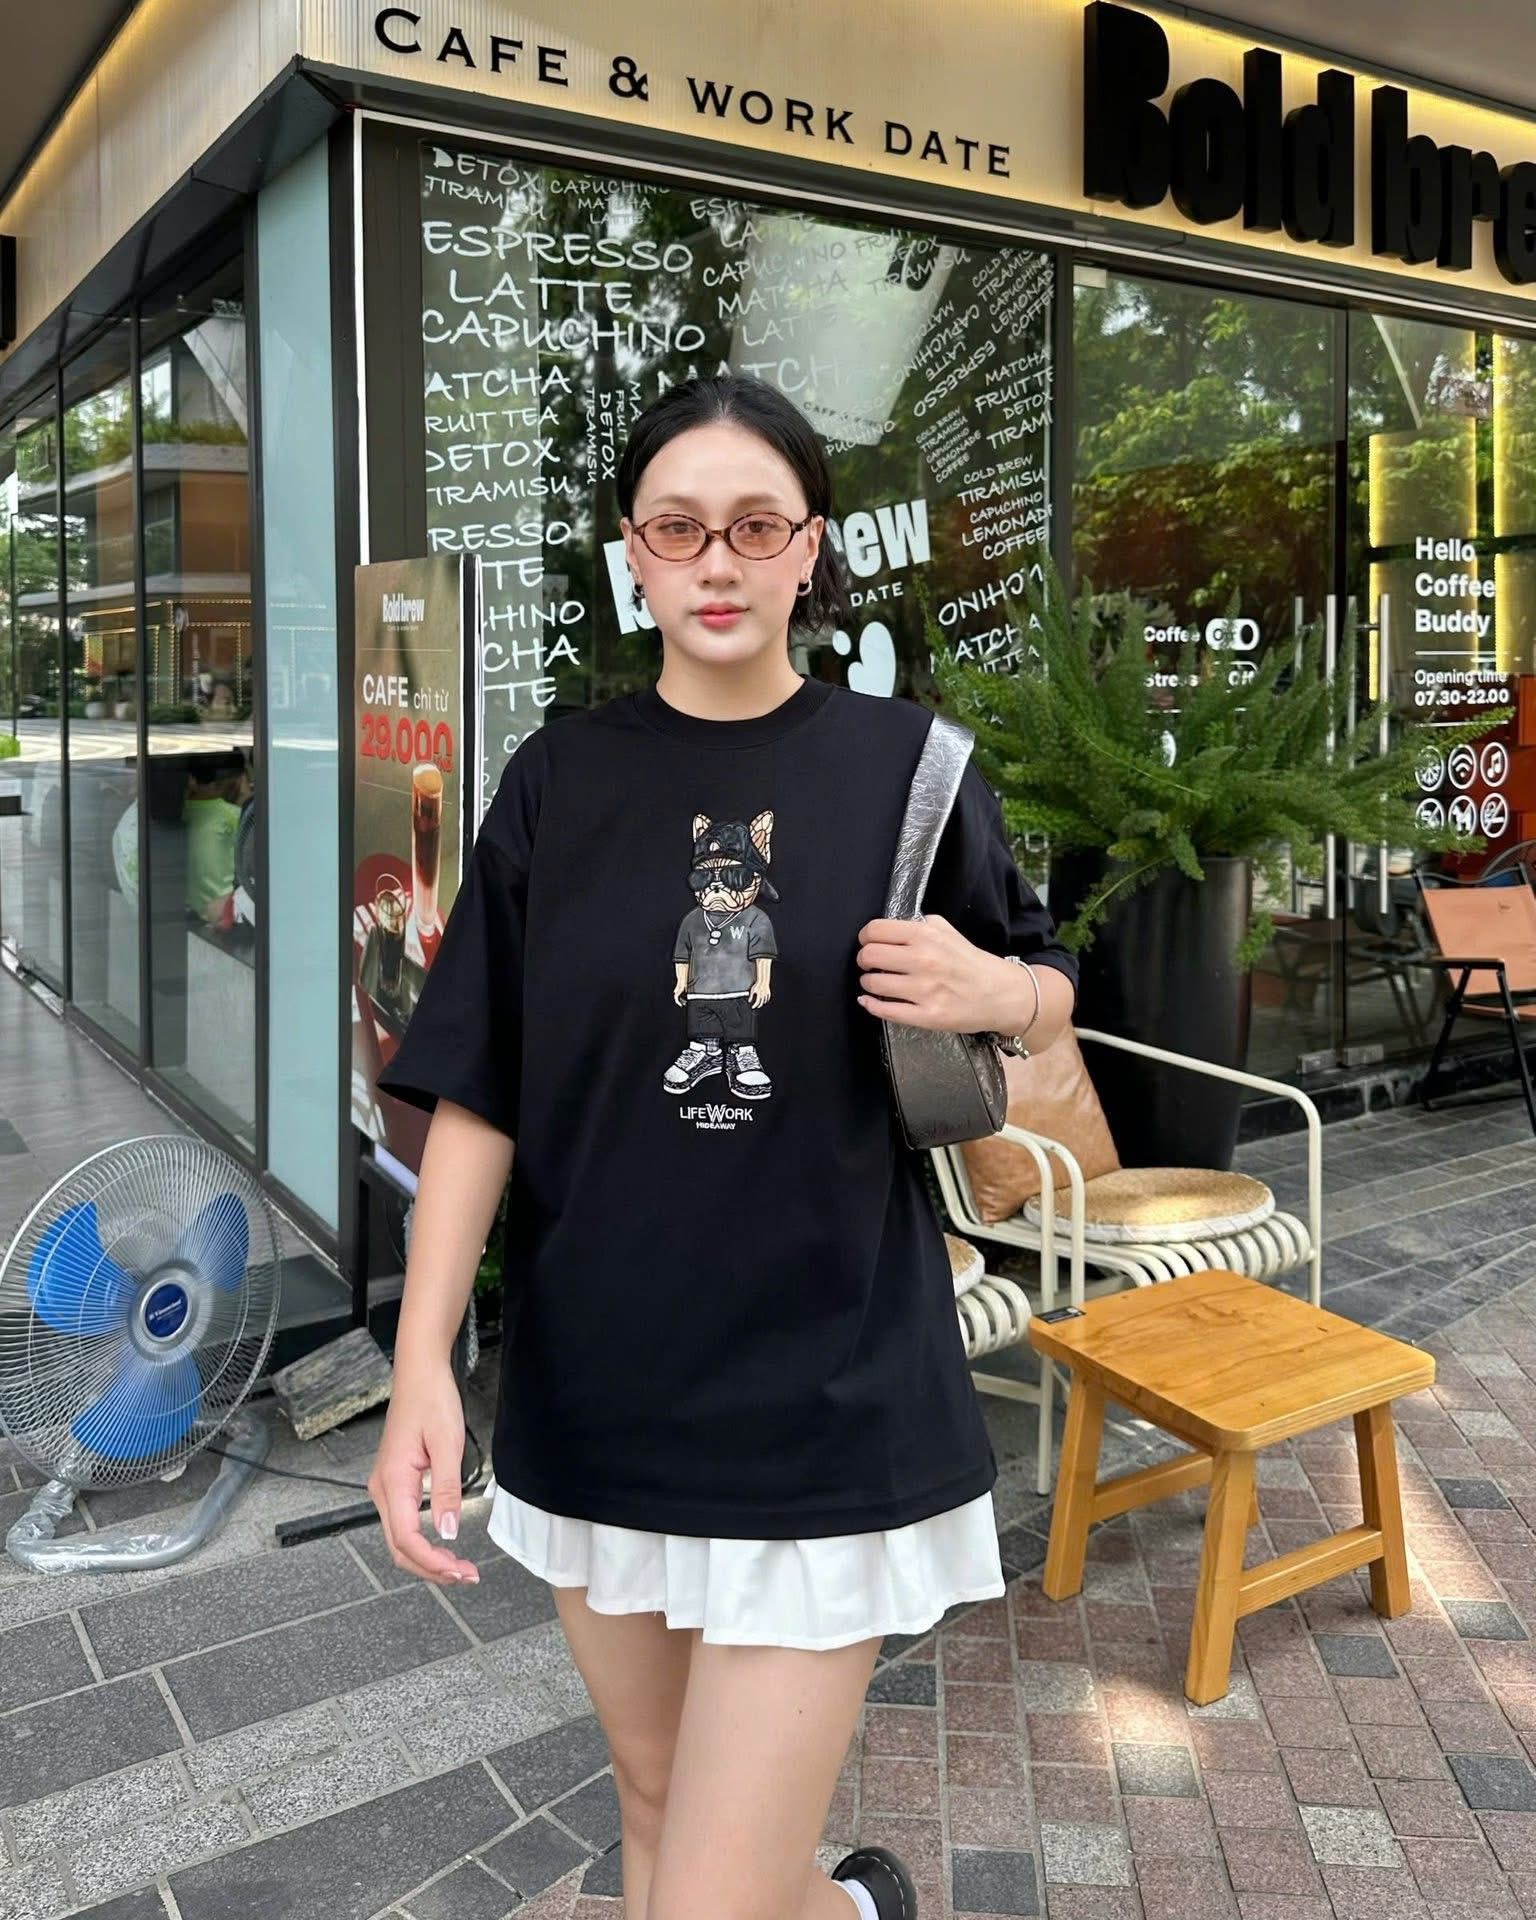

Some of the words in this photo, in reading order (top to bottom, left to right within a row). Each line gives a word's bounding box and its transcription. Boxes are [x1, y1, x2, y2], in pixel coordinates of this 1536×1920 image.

[374, 7, 569, 87] CAFE
[609, 55, 650, 103] &
[686, 76, 857, 145] WORK
[883, 120, 1012, 179] DATE
[1083, 0, 1355, 248] Bold
[432, 147, 542, 194] DETOX
[422, 221, 694, 273] ESPRESSO
[449, 269, 633, 313] LATTE
[421, 309, 706, 352] CAPUCHINO
[913, 340, 996, 417] ESPRESSO
[985, 348, 1050, 386] MATCHA
[974, 376, 1032, 414] FRUIT
[1003, 391, 1054, 421] DETOX
[502, 405, 560, 429] TEA
[586, 386, 598, 485] TIRAMISU
[599, 391, 616, 480] DETOX
[935, 452, 971, 484] COFFEE
[963, 466, 996, 485] COLD
[996, 453, 1034, 475] BREW
[957, 468, 1047, 507] TIRAMISU
[969, 491, 1044, 524] CAPUCHINO
[982, 527, 1049, 560] COFFEE
[1415, 536, 1476, 562] Hello
[850, 581, 904, 608] DATE
[1414, 571, 1496, 598] Coffee
[1415, 608, 1491, 638] Buddy
[362, 673, 409, 708] CAFE
[1414, 668, 1478, 688] Opening
[1414, 689, 1510, 707] 07.30-22.00
[679, 1103, 754, 1122] LIFEWORK
[695, 1121, 736, 1130] HIDEAWAY
